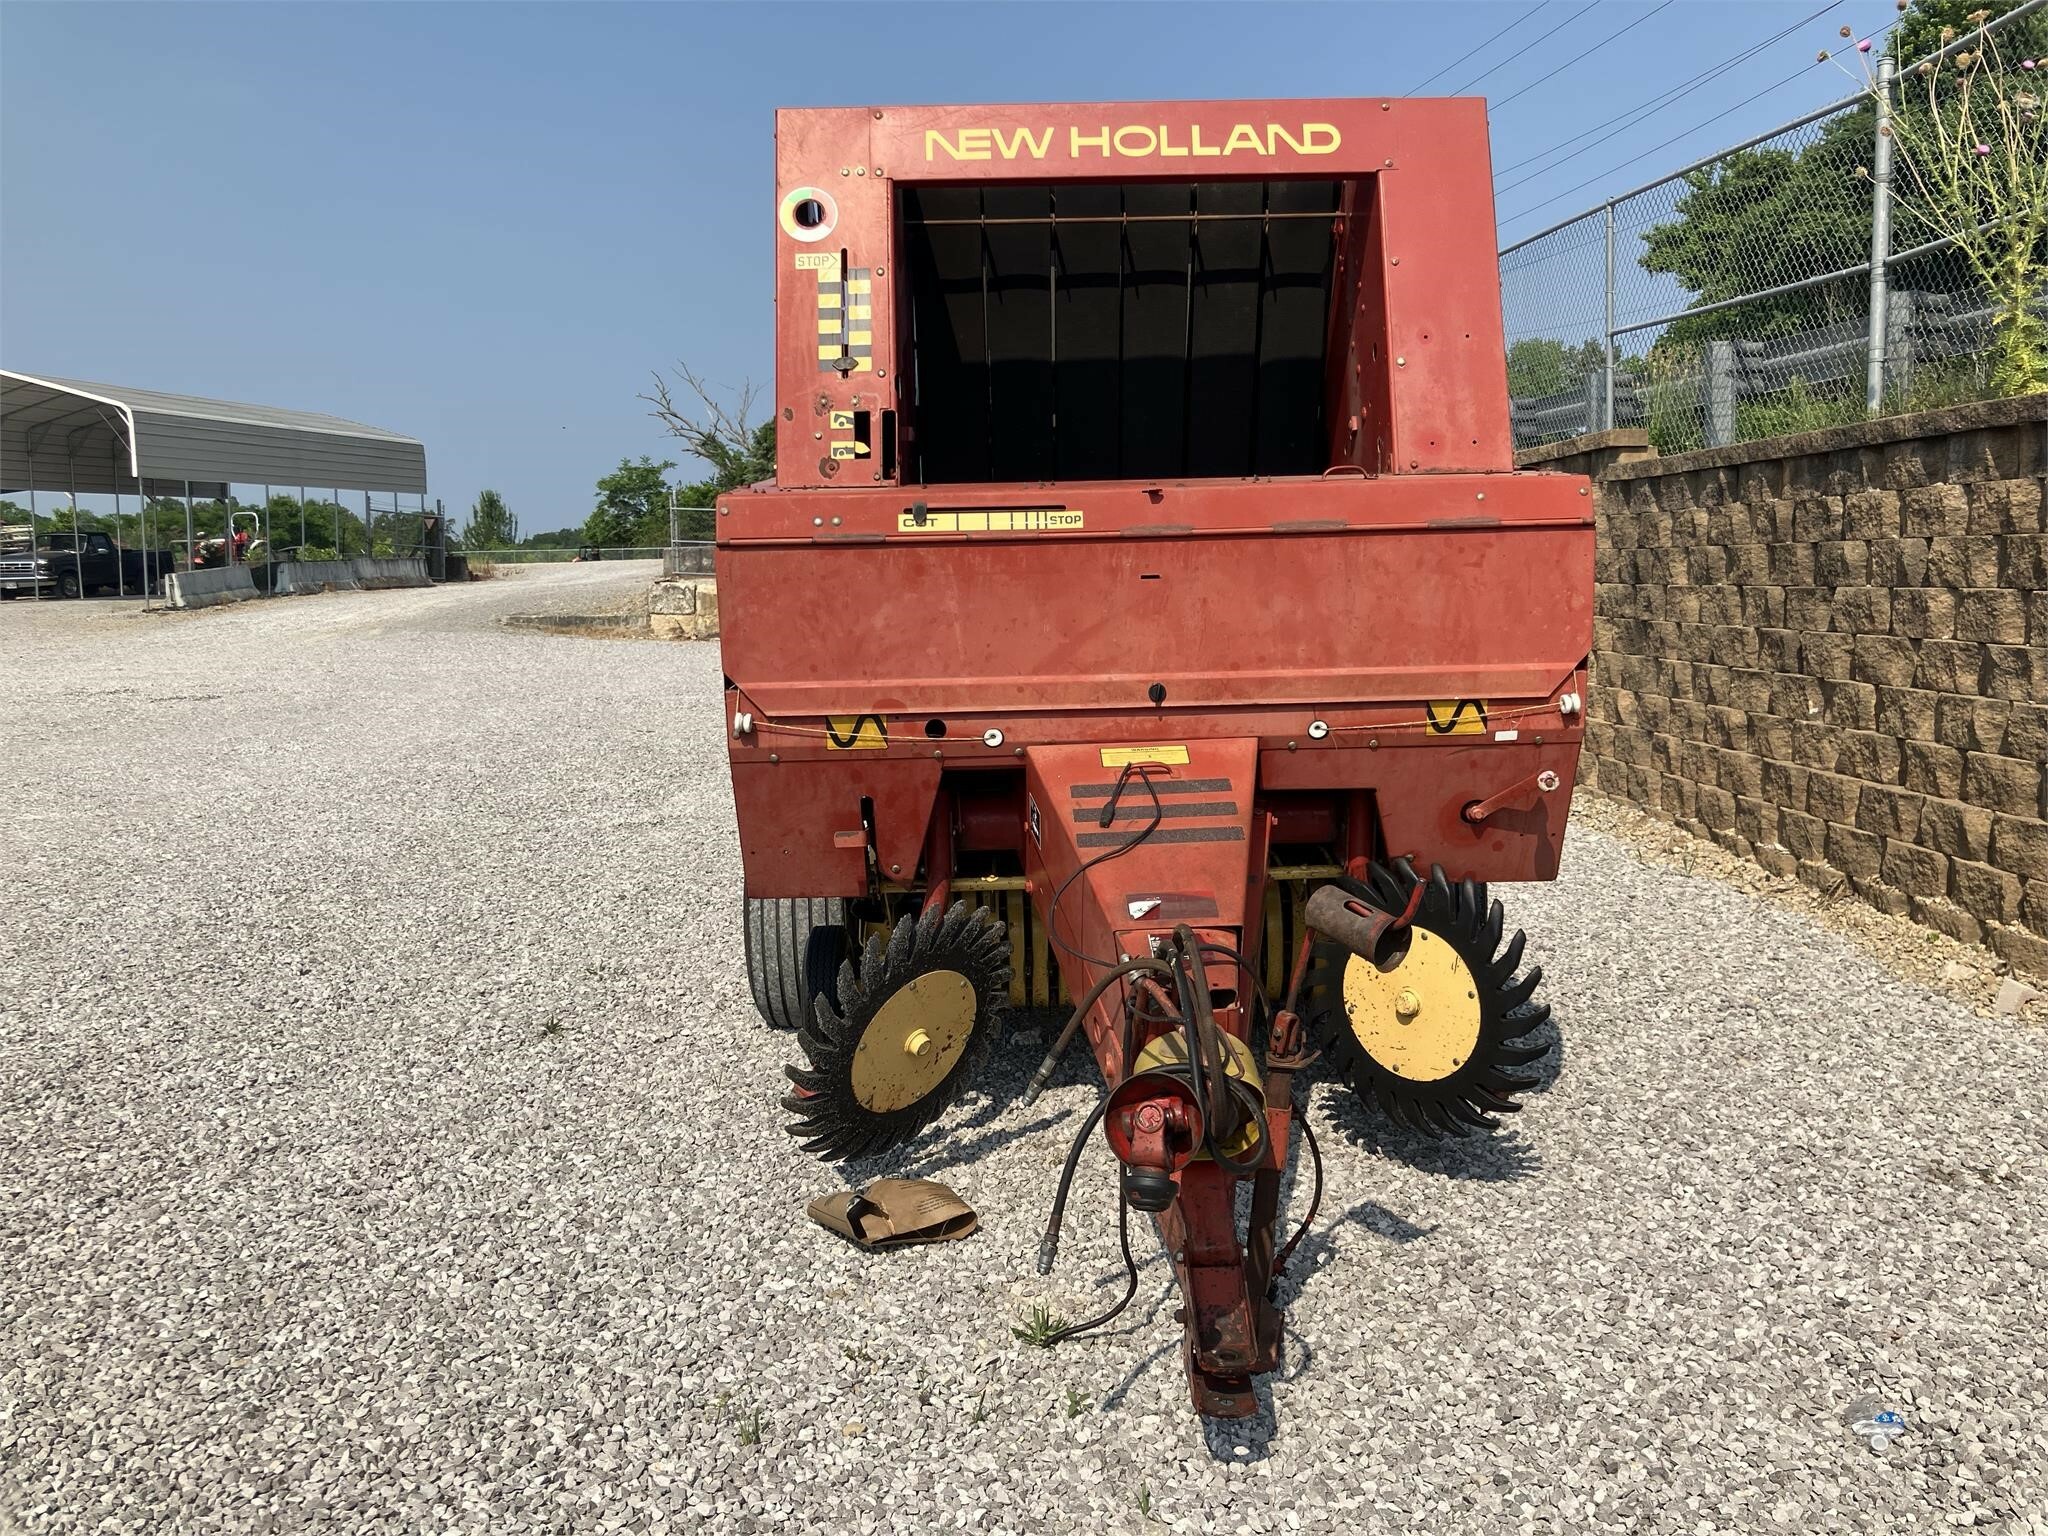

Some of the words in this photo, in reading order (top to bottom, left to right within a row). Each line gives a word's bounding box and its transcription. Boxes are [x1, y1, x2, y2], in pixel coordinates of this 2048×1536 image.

[925, 127, 1054, 161] NEW
[1070, 123, 1342, 158] HOLLAND
[798, 255, 830, 267] STOP
[1049, 515, 1082, 525] STOP
